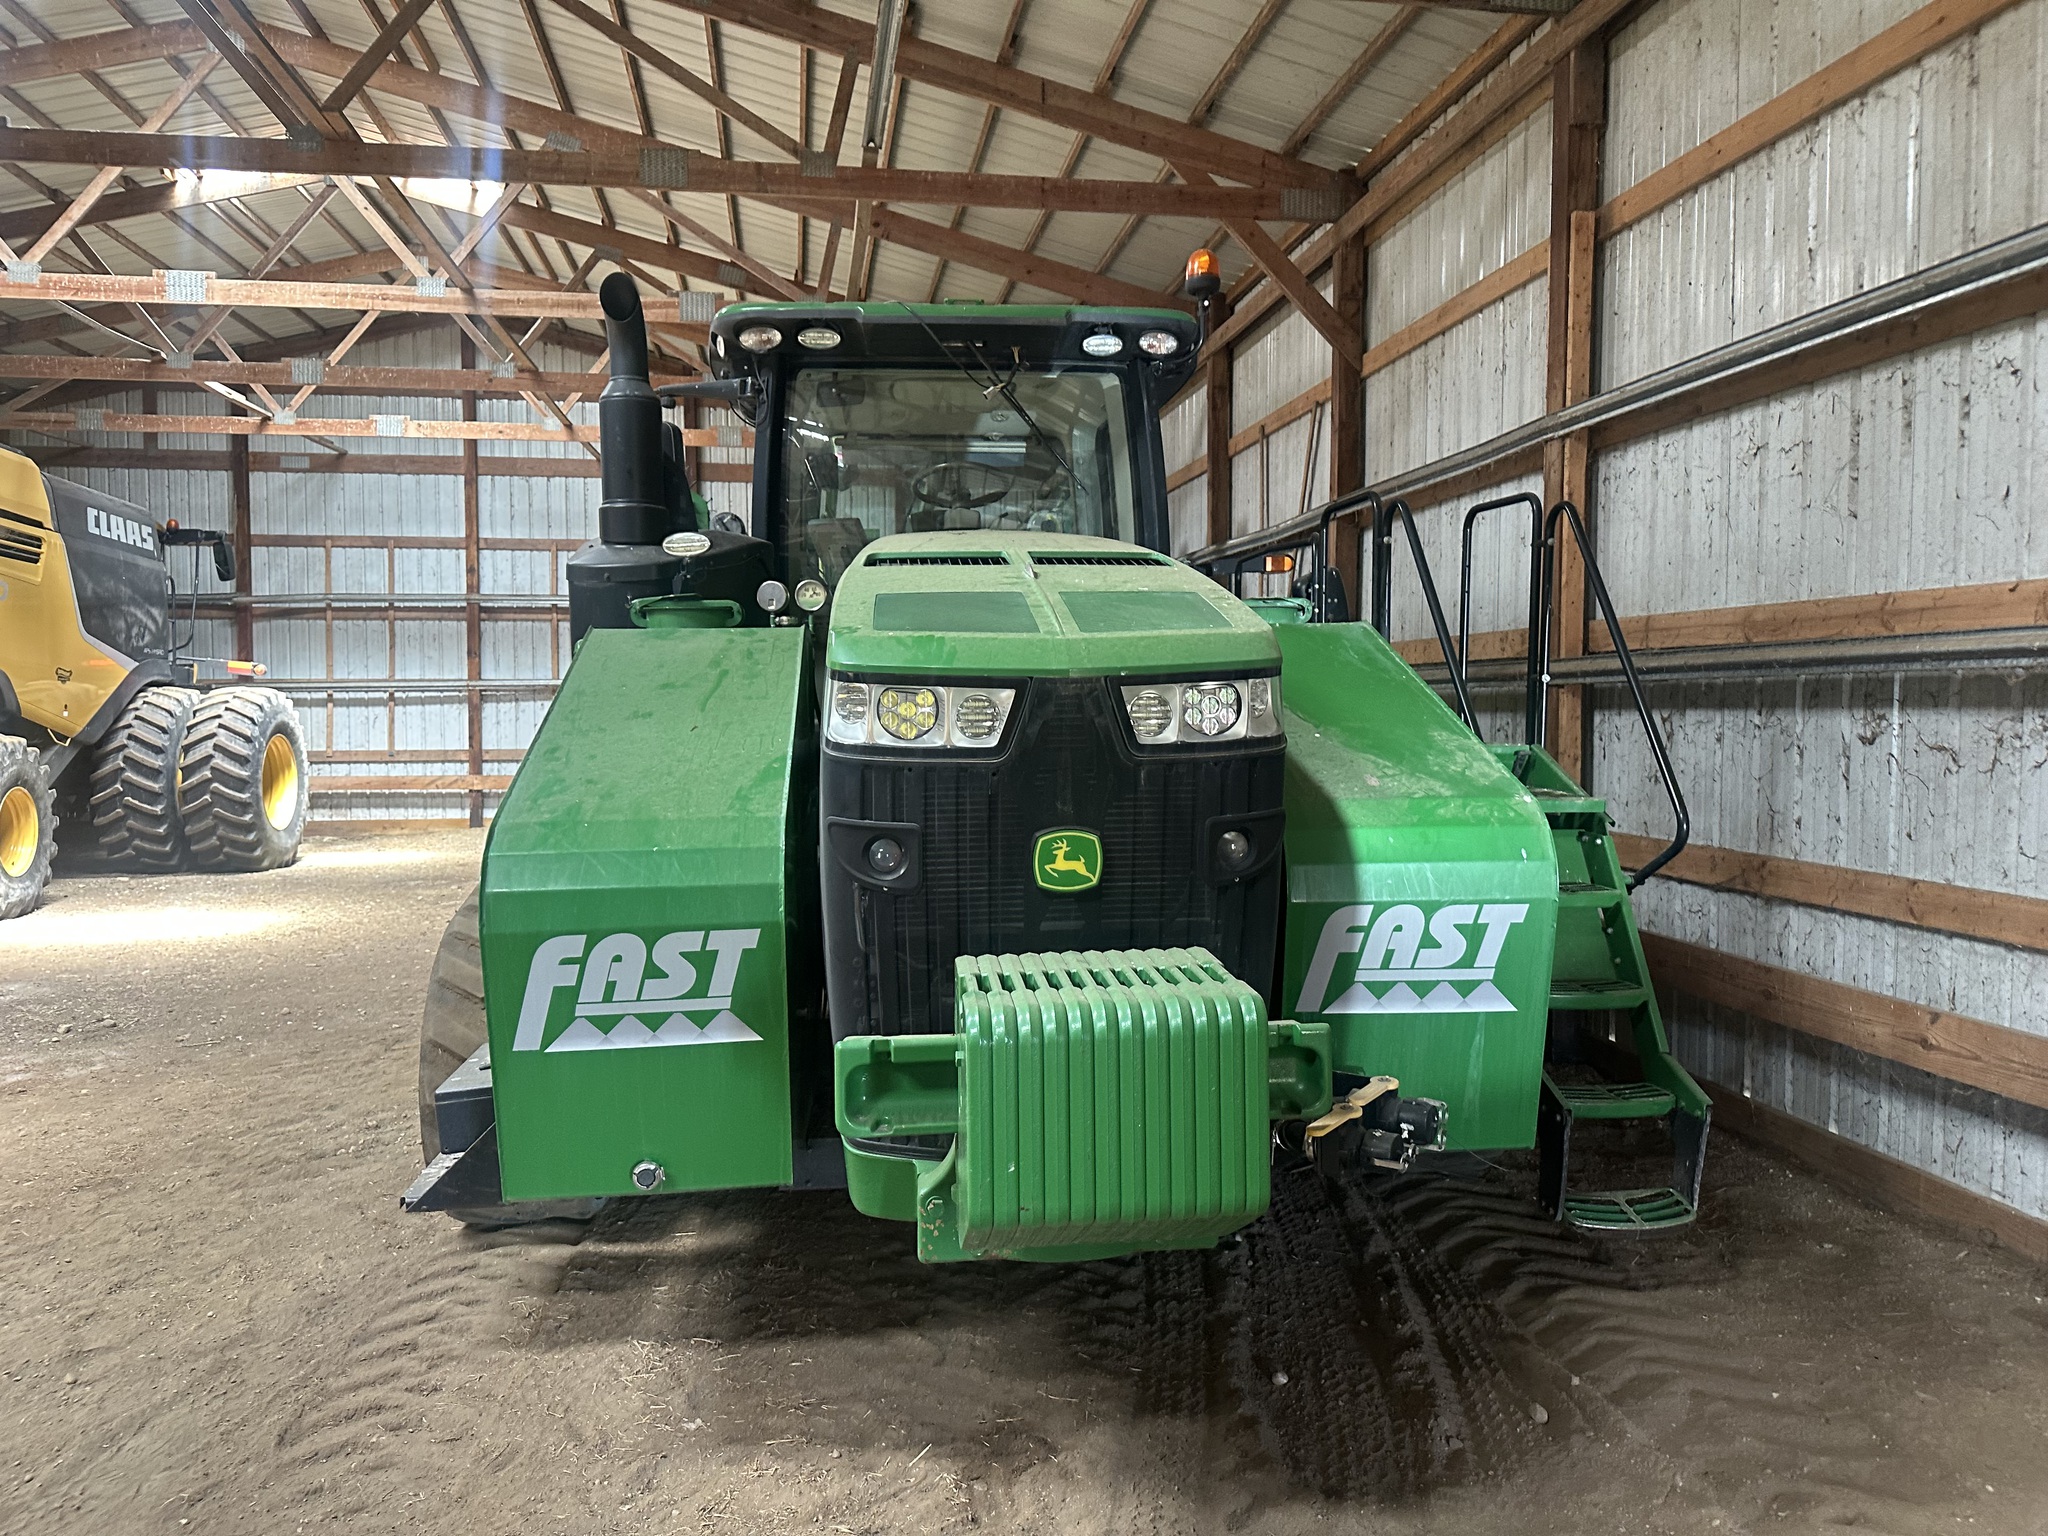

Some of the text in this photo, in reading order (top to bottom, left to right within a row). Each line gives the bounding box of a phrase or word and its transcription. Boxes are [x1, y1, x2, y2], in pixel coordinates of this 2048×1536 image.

[87, 506, 154, 551] CLAAS
[512, 928, 761, 1052] FAST
[1295, 903, 1530, 1013] FAST
